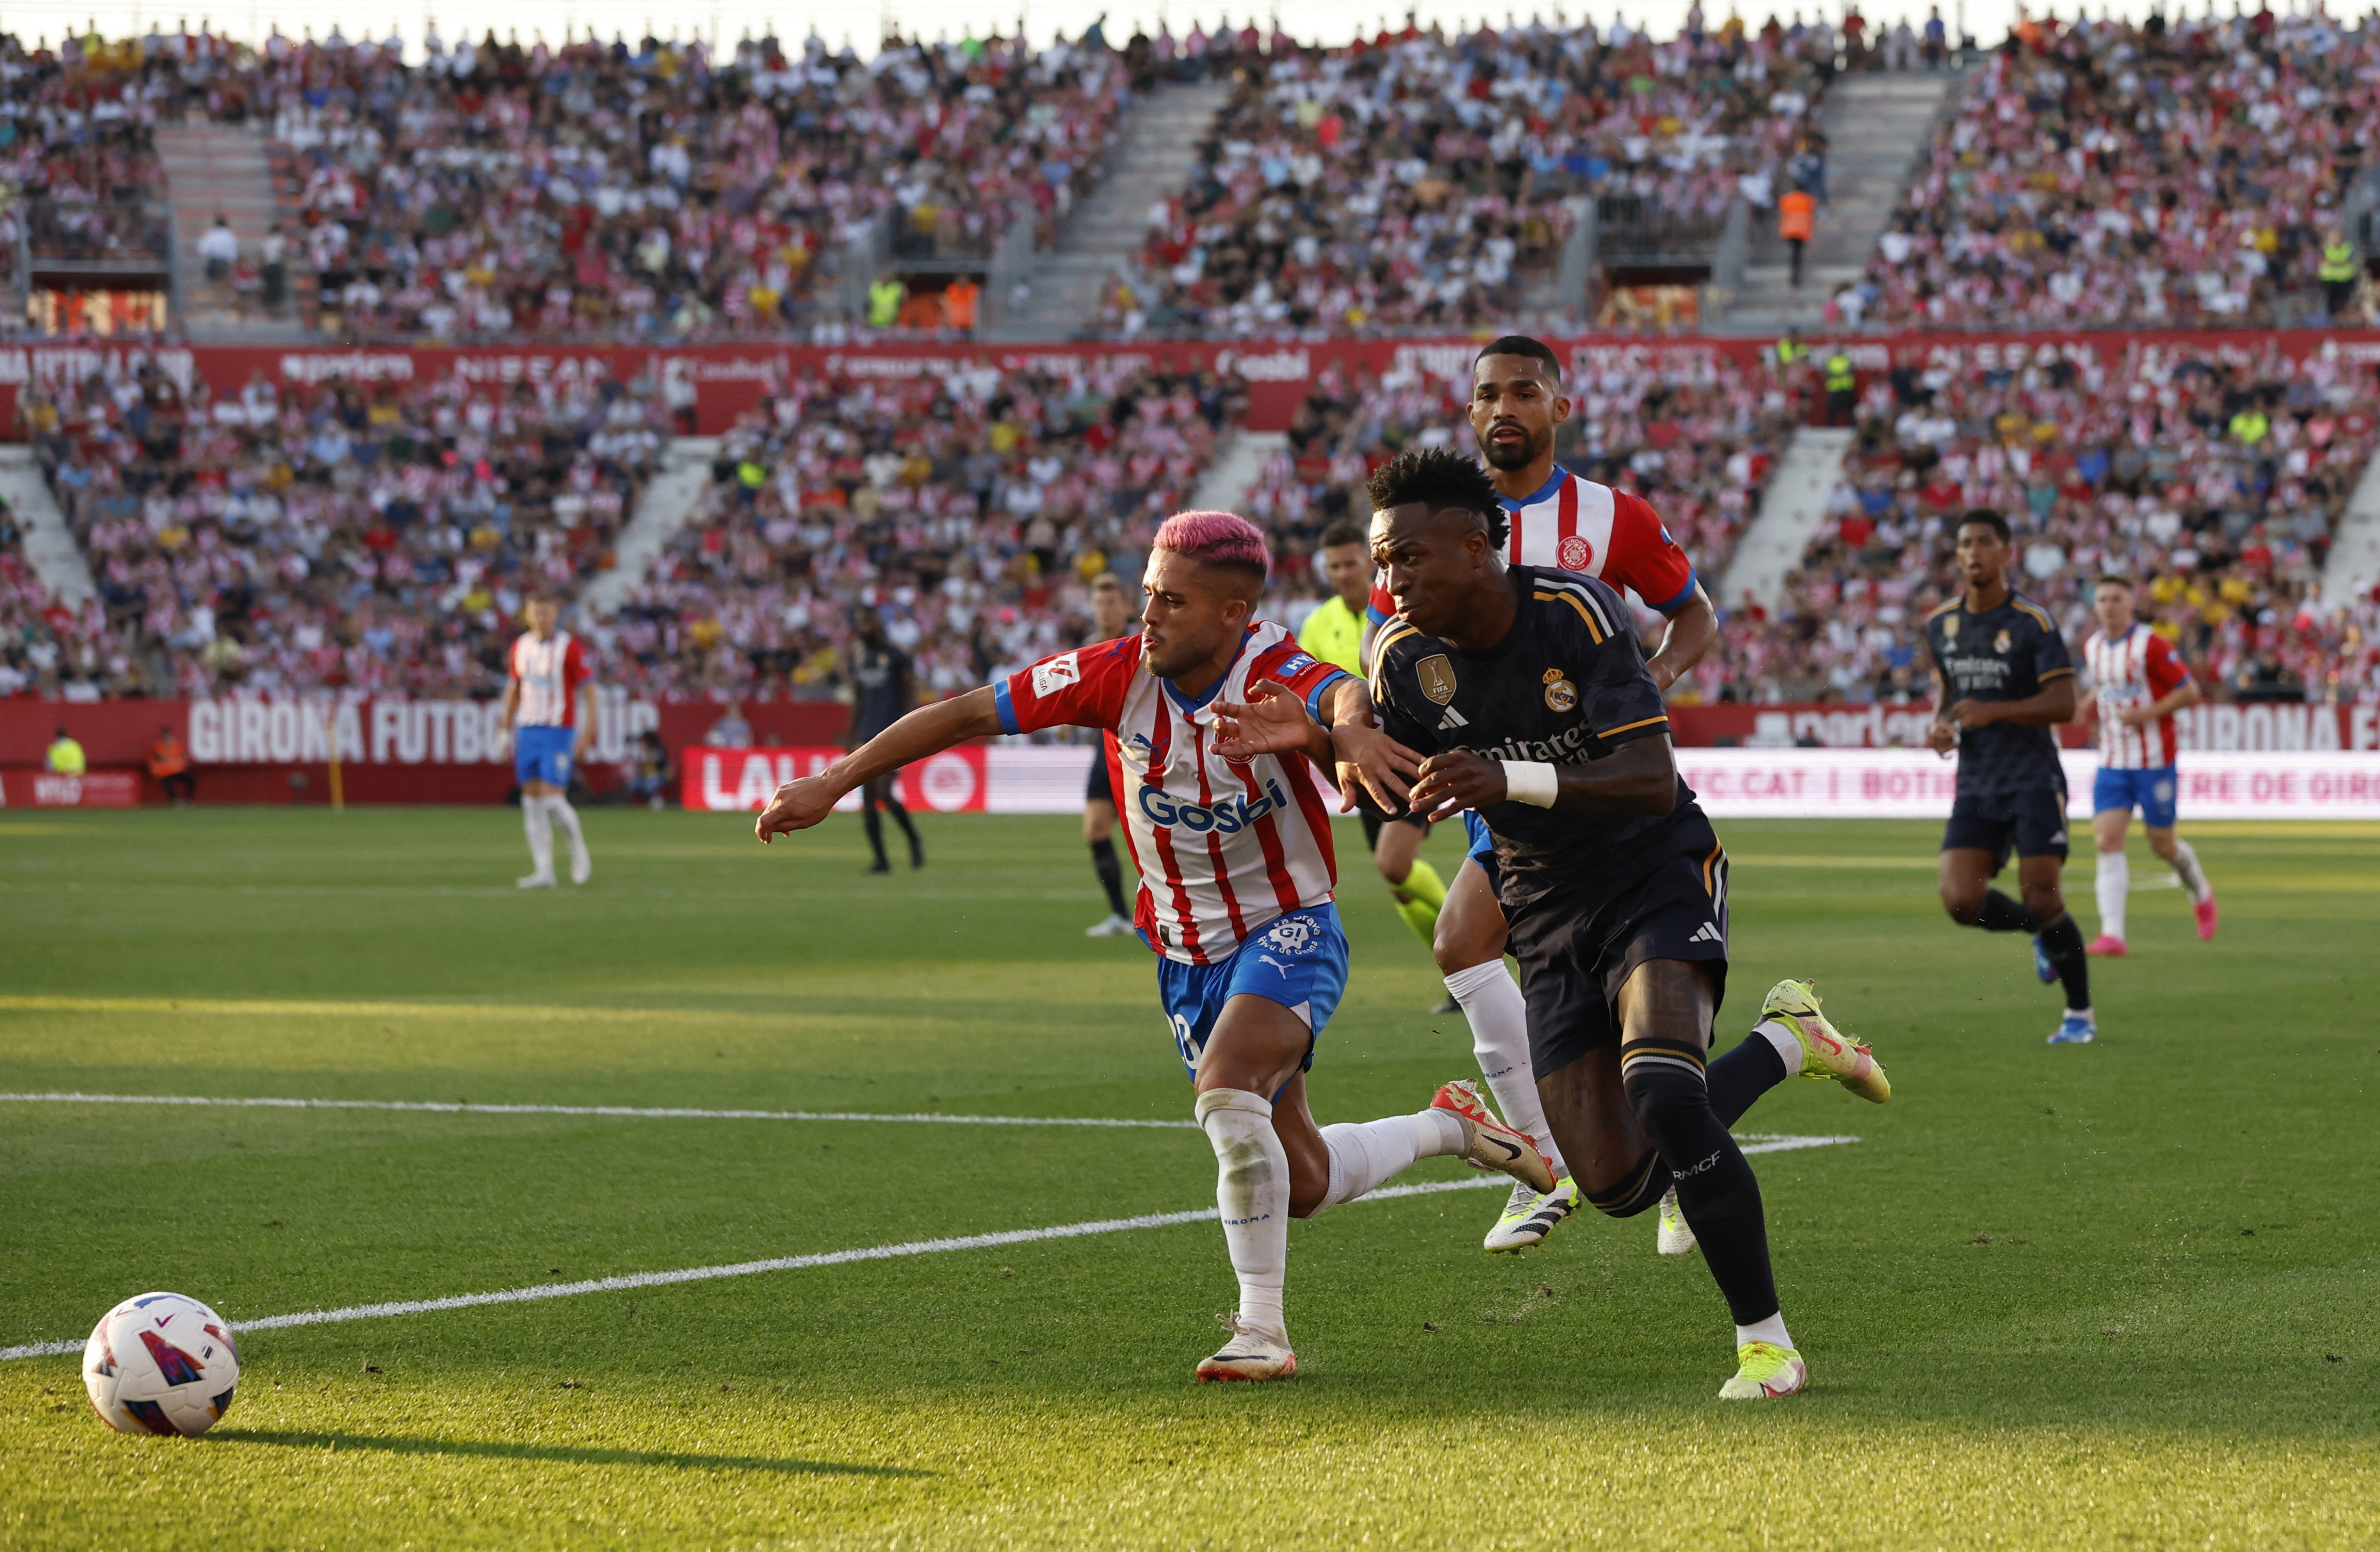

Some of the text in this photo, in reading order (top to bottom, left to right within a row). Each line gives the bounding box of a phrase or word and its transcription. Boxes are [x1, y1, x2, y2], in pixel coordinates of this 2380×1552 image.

[1432, 685, 1448, 694] FIFA
[189, 699, 365, 764] GIRONA
[1447, 718, 1596, 762] mirates
[1138, 778, 1288, 833] Gosbi
[1672, 1149, 1720, 1180] RMCF
[1224, 1214, 1270, 1225] GIRONA
